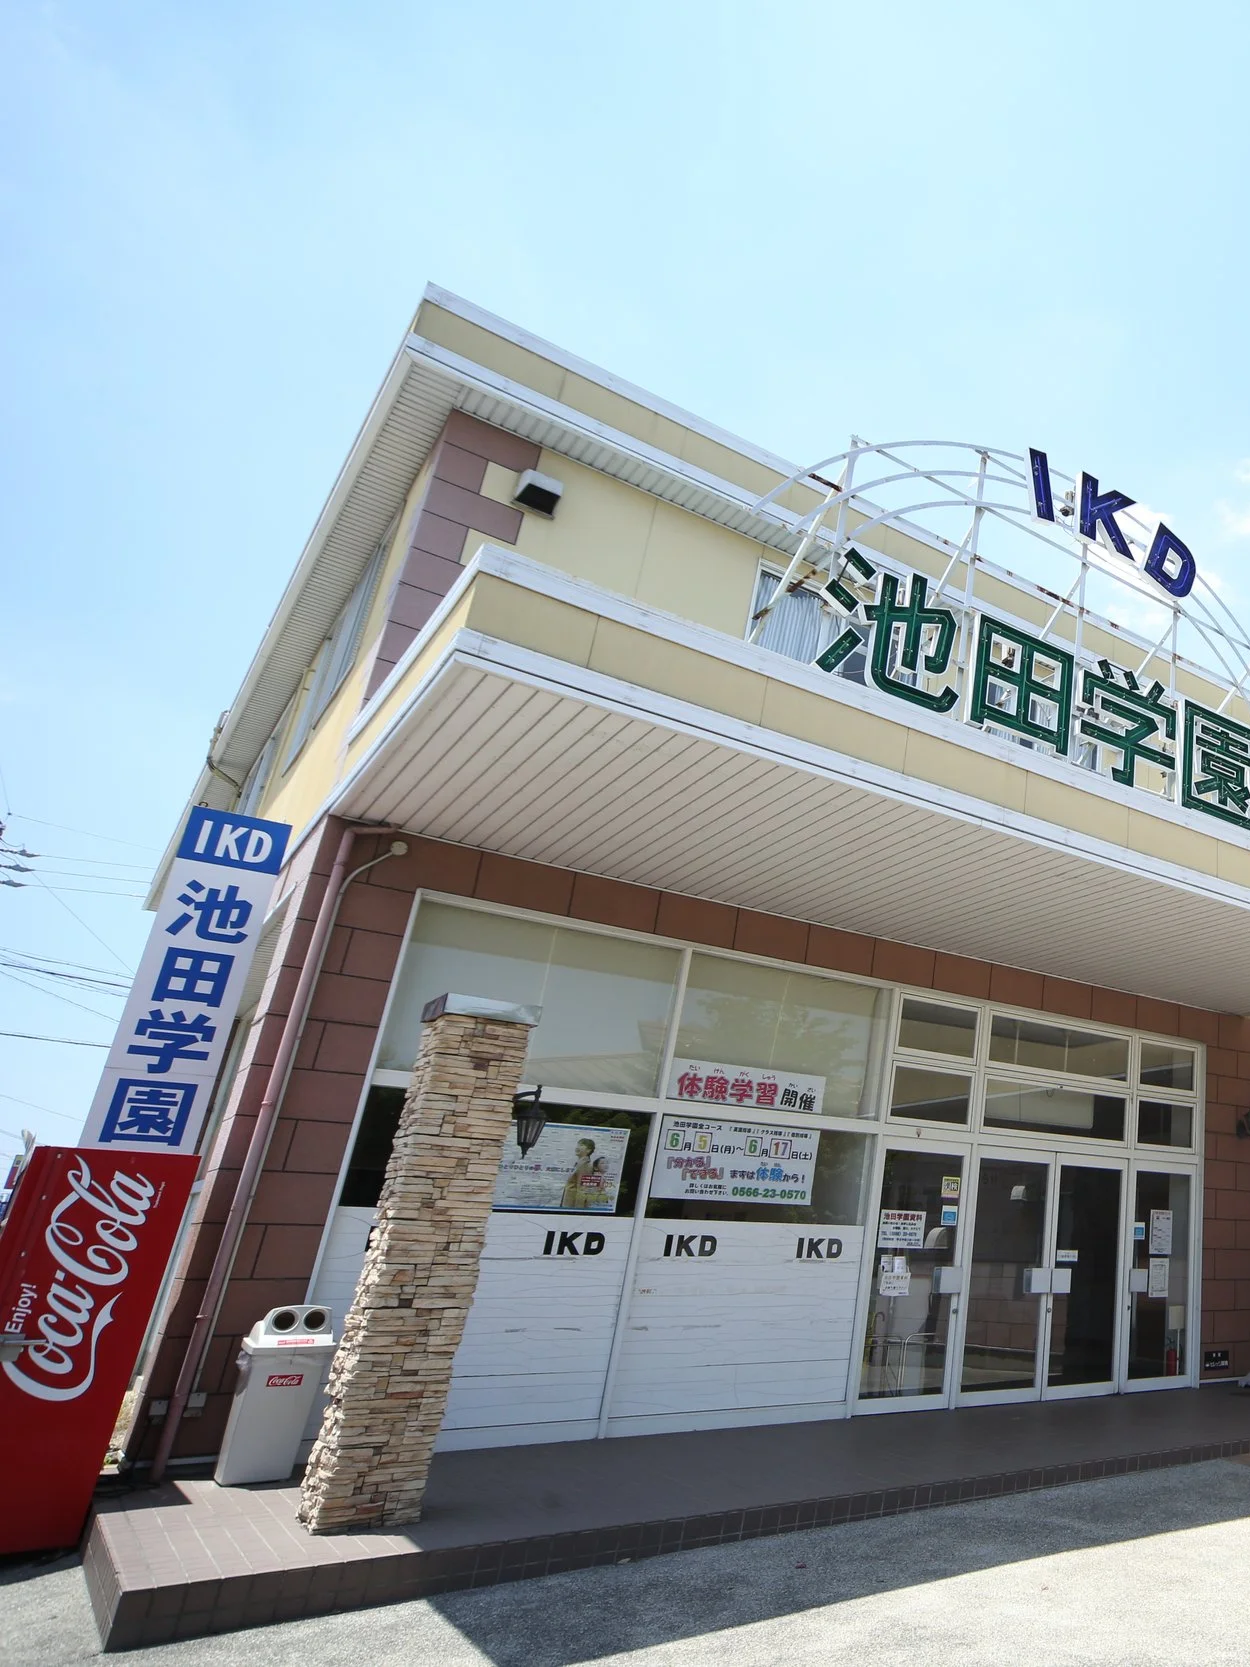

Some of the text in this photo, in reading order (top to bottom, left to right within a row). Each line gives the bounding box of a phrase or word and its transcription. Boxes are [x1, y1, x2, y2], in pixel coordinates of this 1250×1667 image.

[1026, 447, 1196, 600] IKD
[194, 819, 273, 864] IKD
[98, 879, 253, 1146] 池田学園
[731, 1187, 806, 1200] 0566-23-0570
[543, 1231, 606, 1256] IKD
[663, 1234, 718, 1257] IKD
[795, 1237, 843, 1259] IKD
[1, 1153, 155, 1401] Coca-Cola
[5, 1283, 37, 1334] Enjoy!
